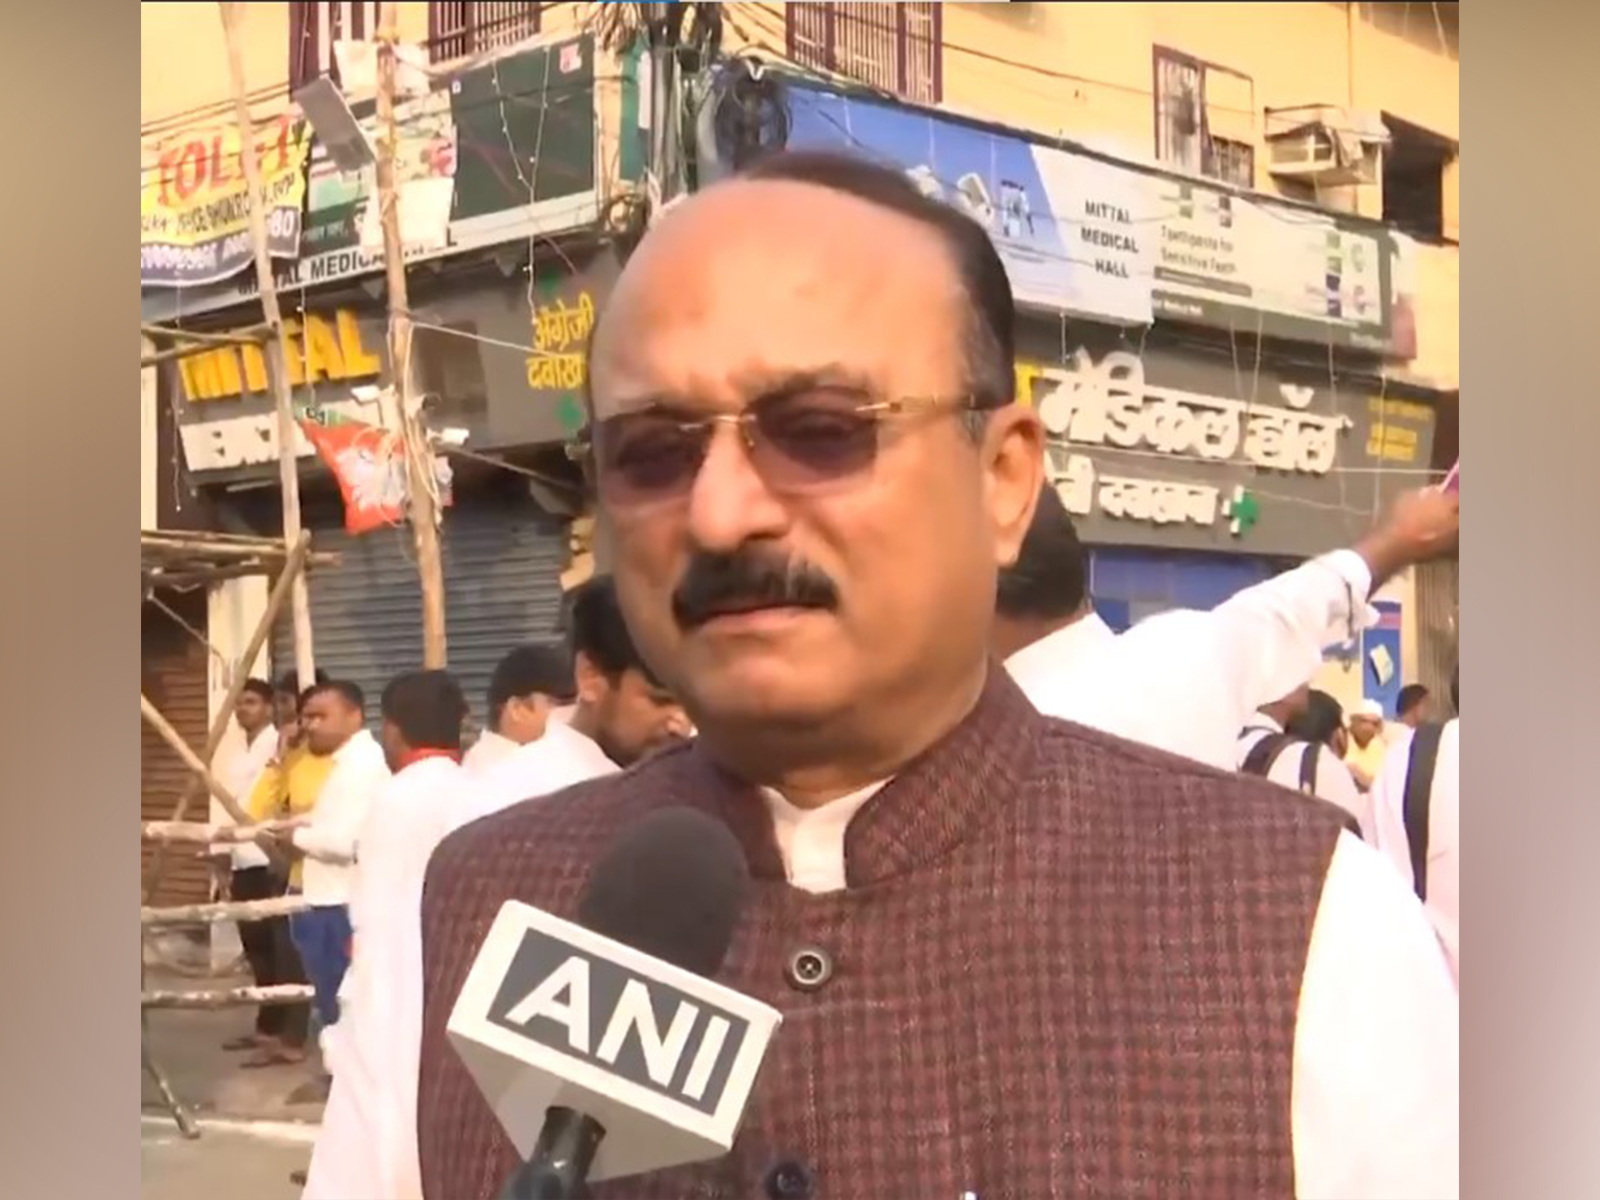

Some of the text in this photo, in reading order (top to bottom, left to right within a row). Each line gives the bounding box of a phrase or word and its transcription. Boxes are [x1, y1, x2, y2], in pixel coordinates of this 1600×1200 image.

[1085, 199, 1133, 224] MITTAL
[1081, 226, 1139, 253] MEDICAL
[1094, 259, 1129, 279] HALL
[179, 308, 382, 401] MITAL
[504, 956, 731, 1102] ANI
